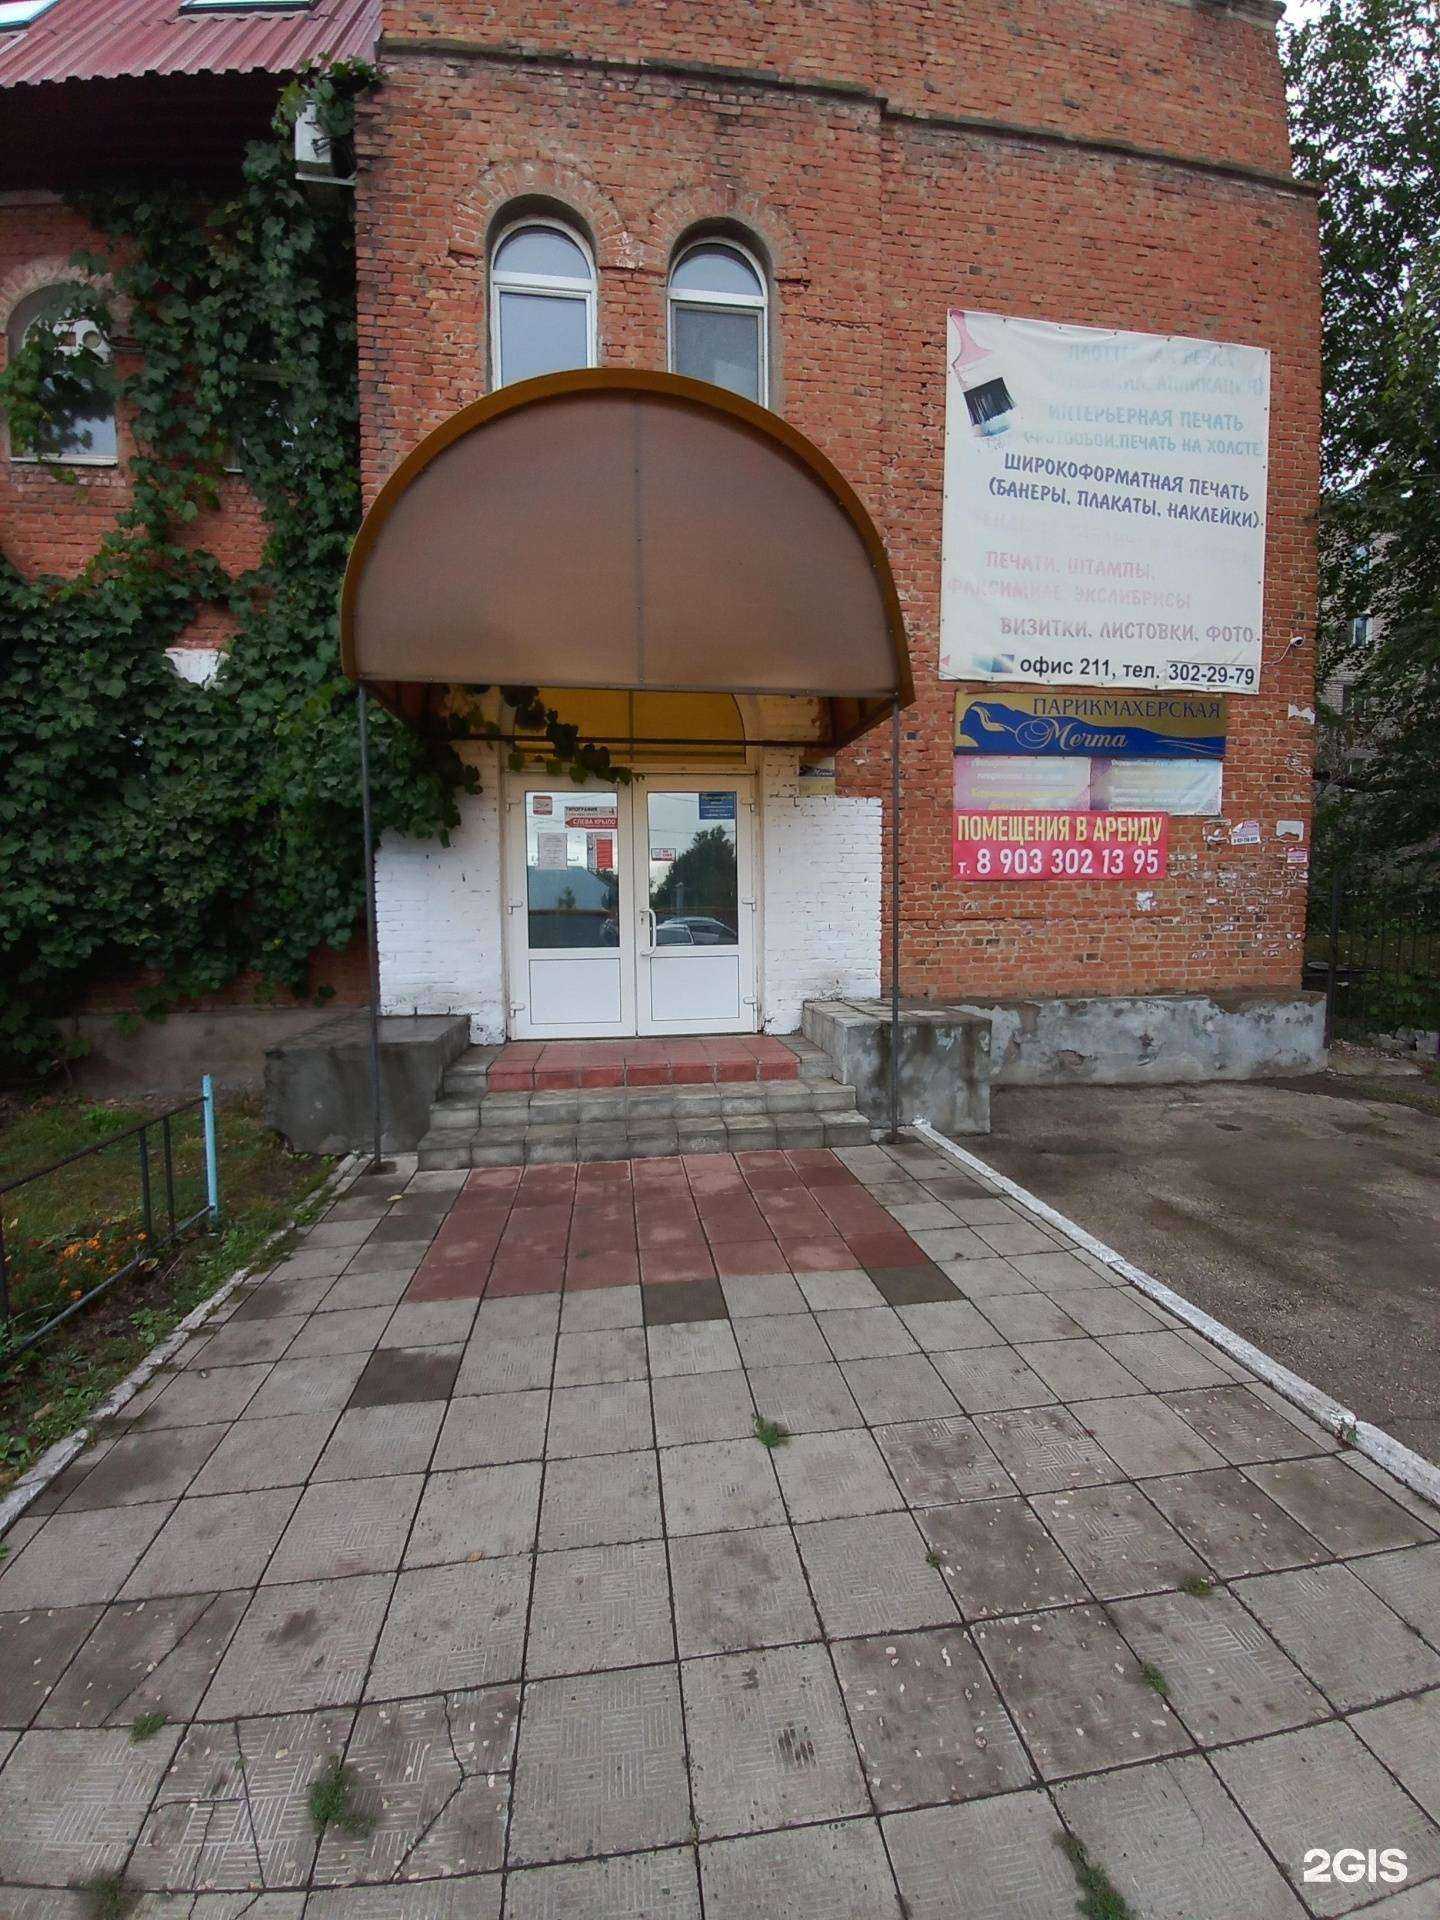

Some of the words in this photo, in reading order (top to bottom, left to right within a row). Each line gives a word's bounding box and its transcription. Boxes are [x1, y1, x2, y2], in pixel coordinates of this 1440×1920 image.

[1180, 410, 1244, 432] ПЕЧАТЬ
[1181, 438, 1202, 454] НА
[1004, 452, 1184, 493] ШИРОКОФОРМАТНАЯ
[1189, 478, 1249, 501] ПЕЧАТЬ
[1020, 656, 1073, 678] офис
[1079, 658, 1116, 680] 211,
[1123, 664, 1160, 680] тел.
[1168, 663, 1255, 686] 302-29-79
[1033, 698, 1221, 719] ПАРИКМАХЕРСКАЯ
[1015, 717, 1129, 752] Мечта
[957, 815, 1070, 846] ПОМЕЩЕНИЯ
[1075, 816, 1087, 842] В
[1092, 816, 1163, 846] АРЕНДУ
[958, 861, 971, 875] т.
[976, 848, 992, 875] 8
[1000, 848, 1043, 875] 903
[1050, 848, 1094, 874] 302
[1102, 849, 1124, 874] 13
[1132, 849, 1159, 874] 95
